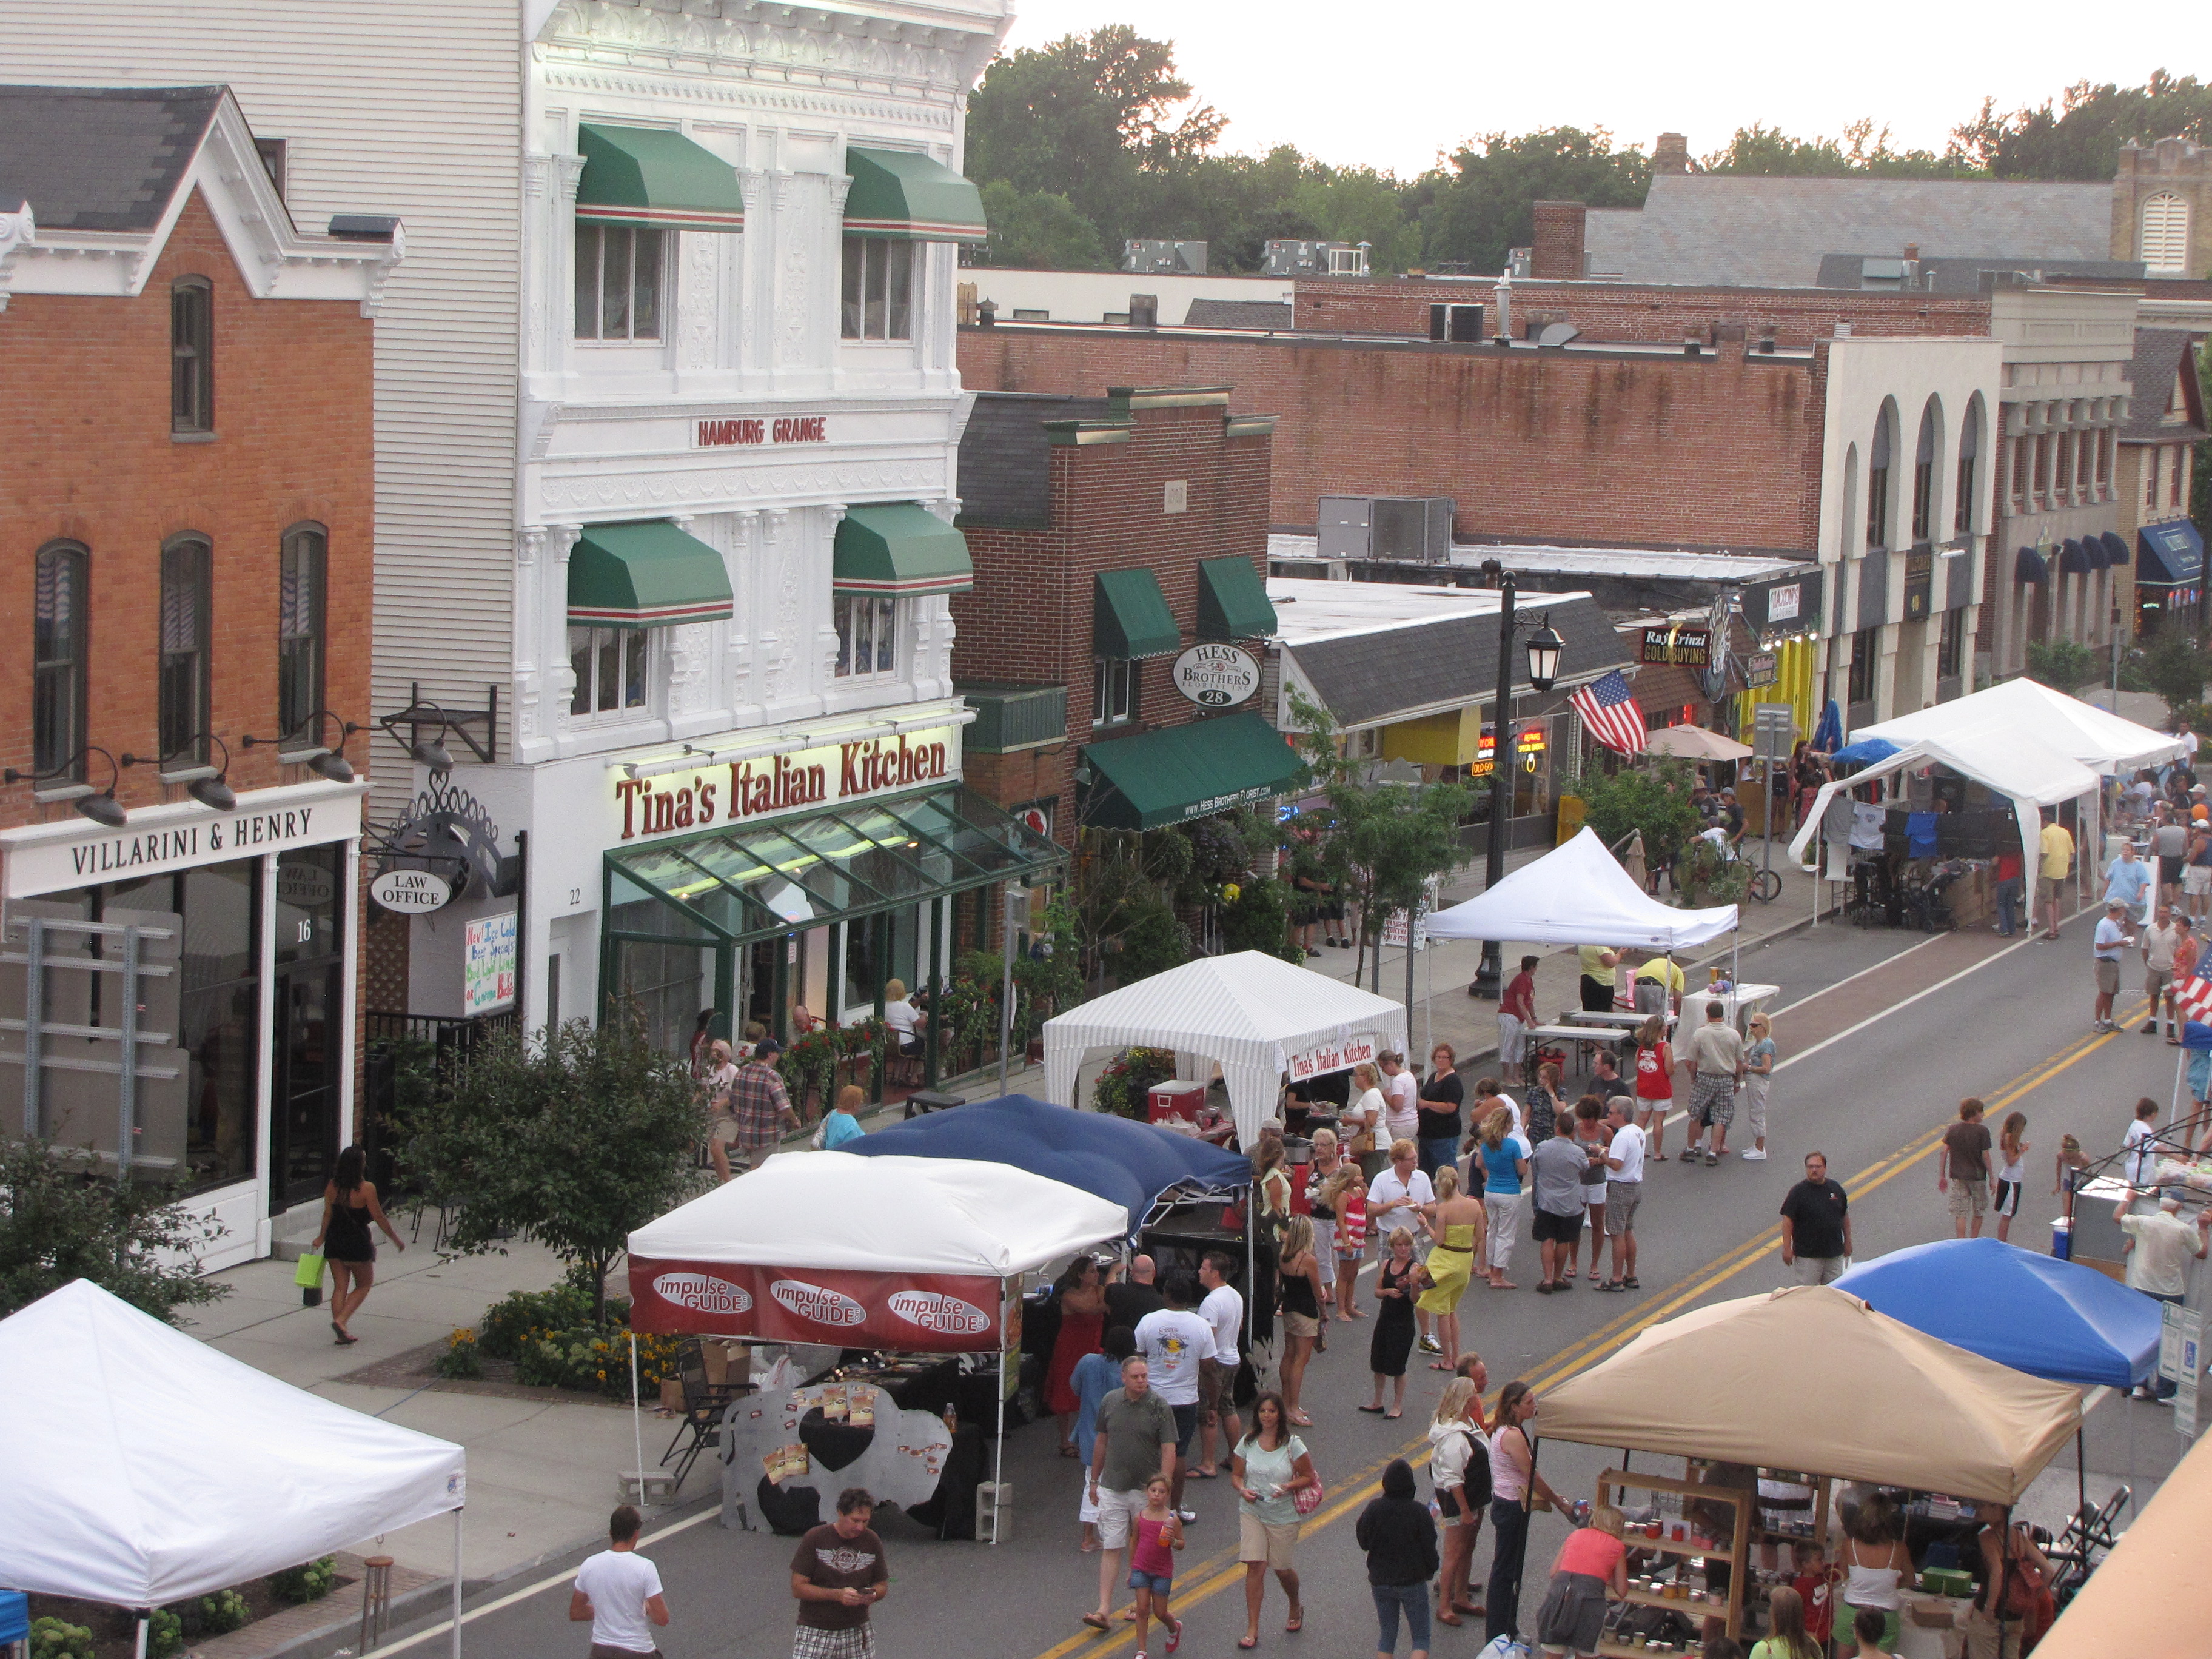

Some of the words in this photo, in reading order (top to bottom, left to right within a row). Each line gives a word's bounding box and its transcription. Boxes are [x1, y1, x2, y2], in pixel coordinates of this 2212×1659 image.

[699, 419, 765, 446] HAMBURG
[773, 417, 826, 443] GRANGE
[1195, 645, 1240, 663] HESS
[1644, 645, 1668, 662] GOLD
[1672, 646, 1706, 664] BUYING
[1182, 681, 1227, 689] FLORIST
[1183, 667, 1250, 686] BROTHERS
[1206, 691, 1224, 703] 28
[616, 776, 717, 839] Tina's
[728, 754, 827, 818] Italian
[839, 734, 947, 797] Kitchen
[72, 826, 198, 875] VILLARINI
[210, 822, 223, 850] &
[235, 808, 313, 847] HENRY
[394, 874, 428, 890] LAW
[382, 889, 440, 905] OFFICE
[569, 888, 580, 905] 22
[297, 919, 312, 943] 16
[1292, 1052, 1313, 1077] Tina's
[1316, 1047, 1340, 1071] Italian
[1344, 1038, 1372, 1065] Kitchen
[660, 1275, 728, 1299] impulse
[776, 1282, 842, 1307] impulse
[684, 1295, 742, 1311] GUIDE
[893, 1293, 964, 1318] impulse
[797, 1304, 854, 1324] GUIDE
[917, 1313, 978, 1332] GUIDE
